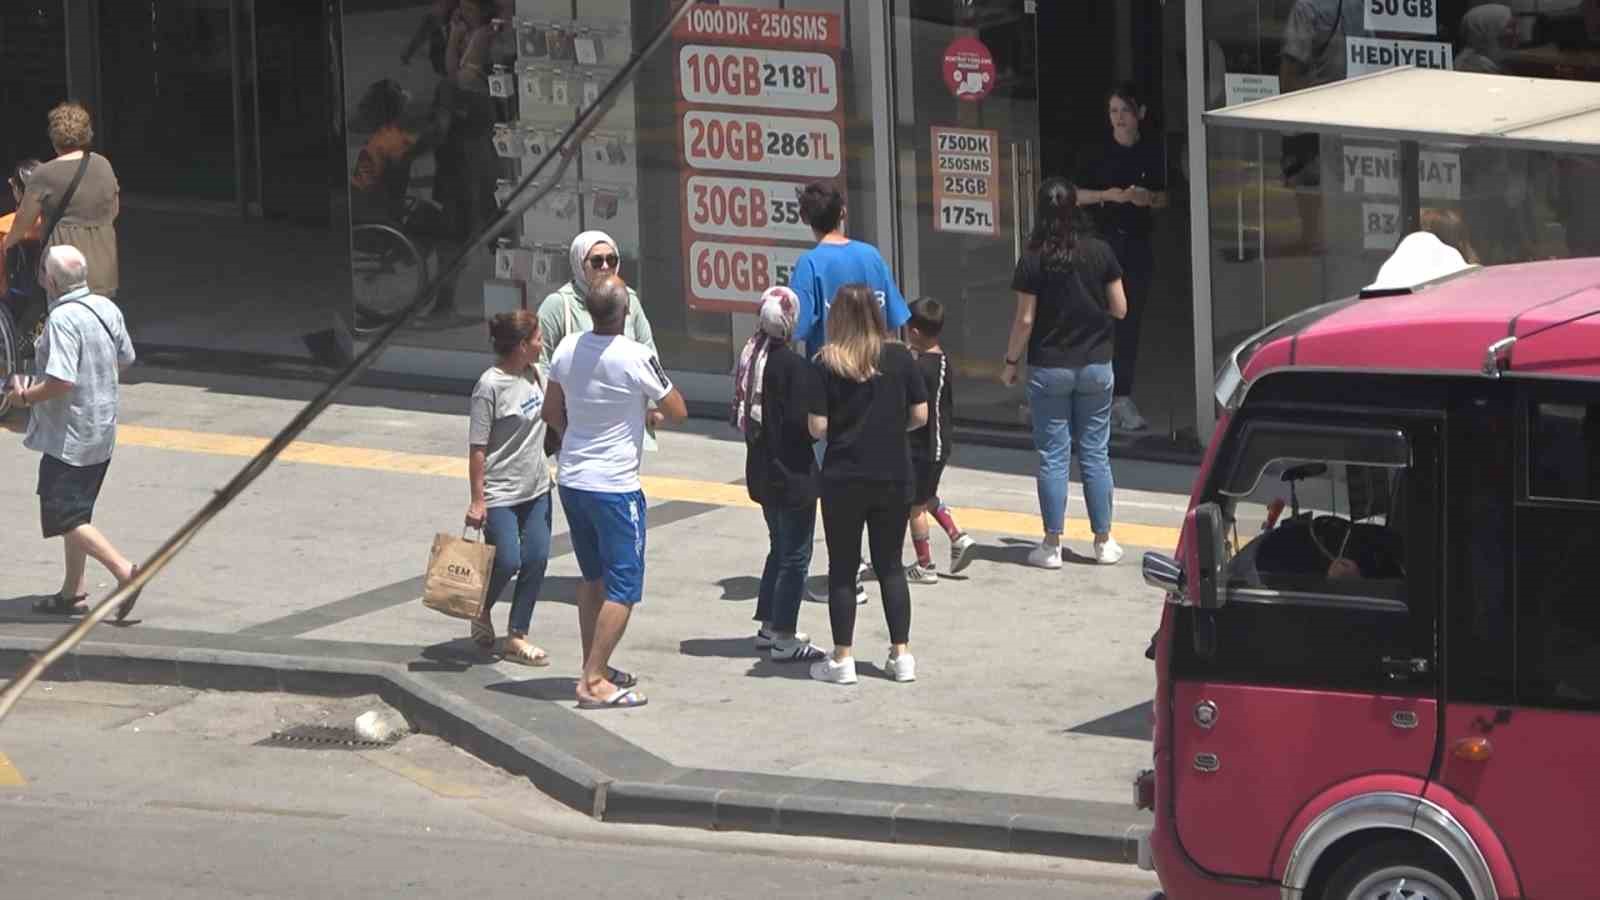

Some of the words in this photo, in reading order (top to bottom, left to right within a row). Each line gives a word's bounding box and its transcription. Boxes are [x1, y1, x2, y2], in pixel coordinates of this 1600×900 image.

[1371, 0, 1399, 16] 50
[1403, 0, 1433, 18] GB
[686, 9, 724, 33] 1000
[727, 11, 749, 35] DK
[760, 14, 791, 39] 250
[793, 15, 828, 41] SMS
[1351, 42, 1447, 70] HEDİYELİ
[687, 53, 761, 97] 10GB
[689, 118, 764, 162] 20GB
[939, 134, 989, 153] 750DK
[940, 156, 990, 172] 250SMS
[945, 177, 987, 194] 25GB
[693, 184, 768, 228] 30GB
[771, 200, 800, 225] 35
[942, 205, 993, 227] 175TL
[1368, 212, 1399, 235] 83
[697, 247, 770, 292] 60GB
[775, 264, 795, 286] 5
